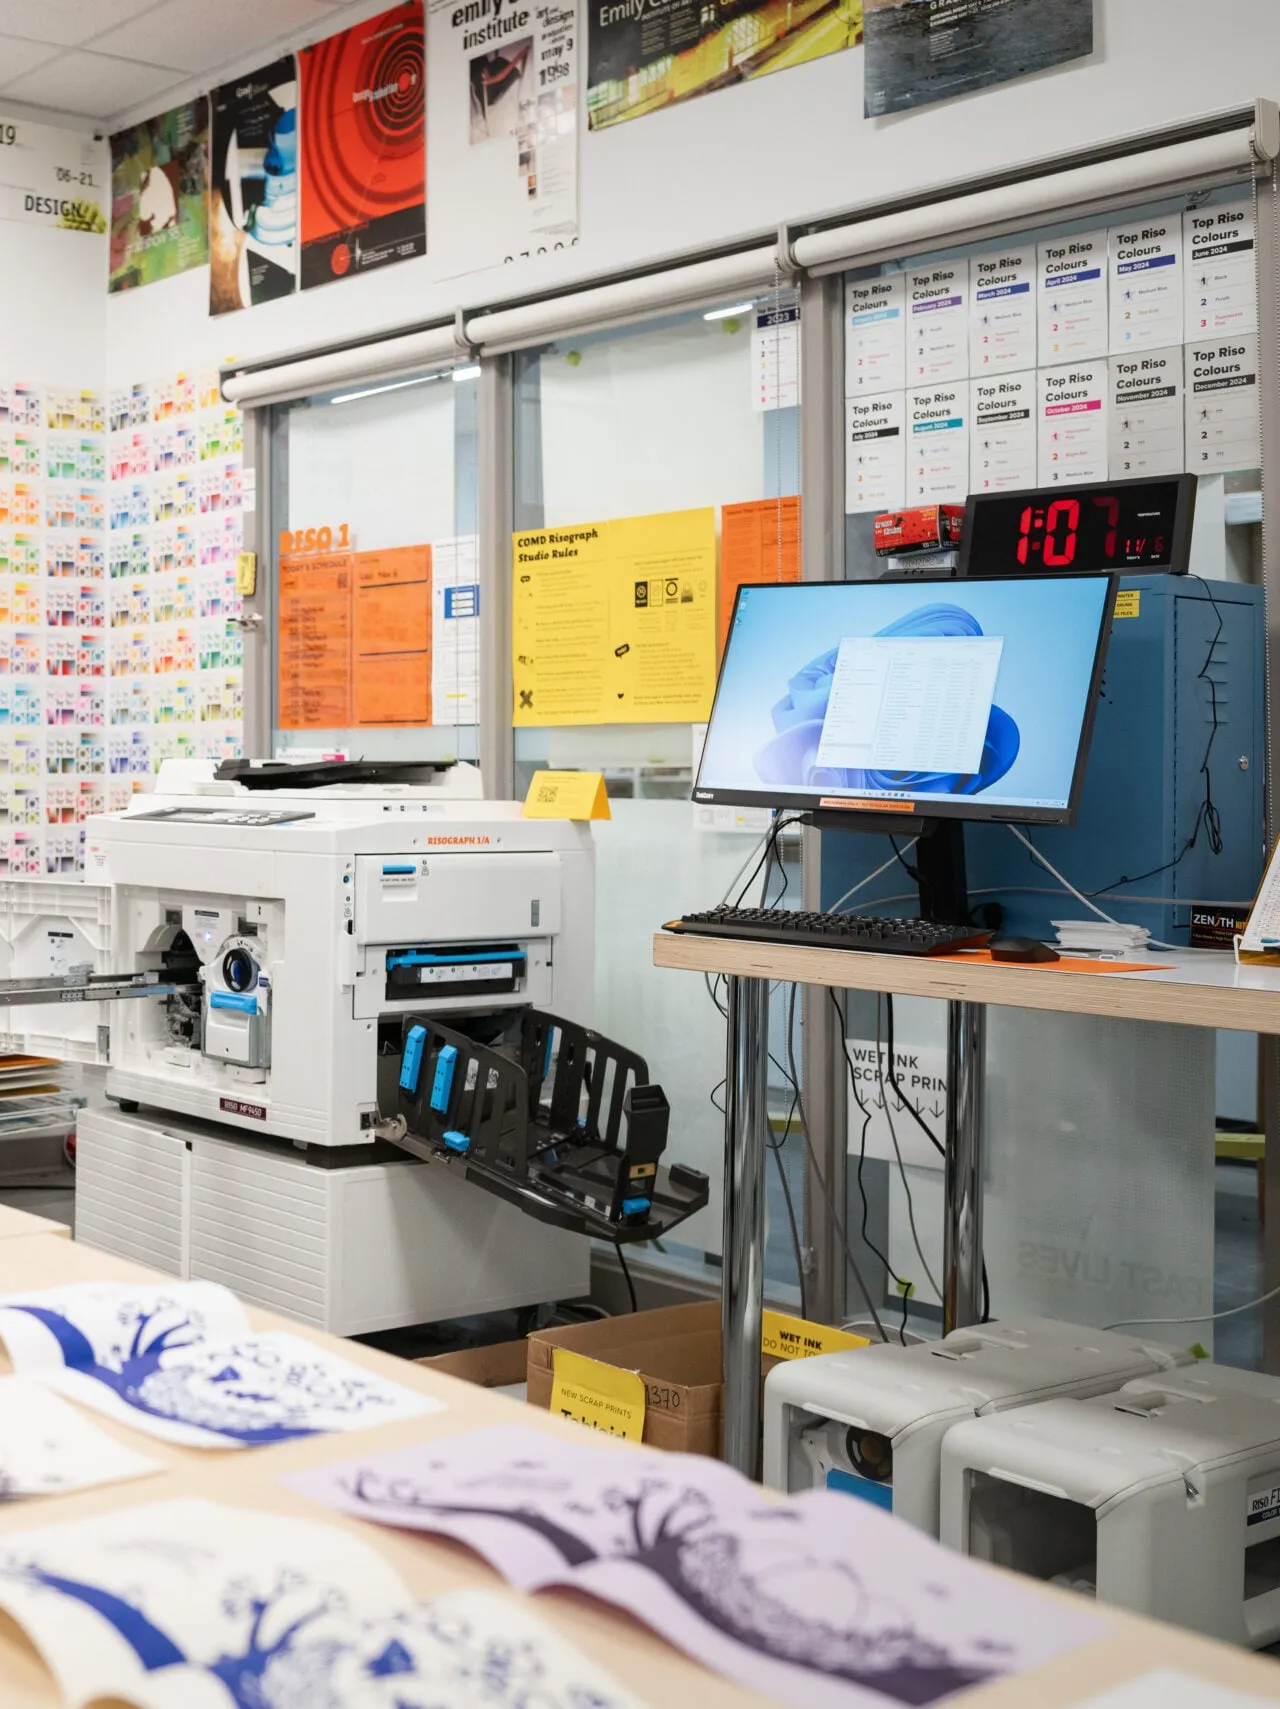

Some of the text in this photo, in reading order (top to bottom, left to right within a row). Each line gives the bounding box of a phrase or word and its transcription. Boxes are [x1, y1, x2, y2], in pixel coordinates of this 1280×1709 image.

[463, 10, 530, 50] institute
[541, 38, 573, 61] may 9
[25, 195, 83, 218] DESIGN
[1192, 211, 1244, 230] Top Riso
[1117, 228, 1166, 245] Top Riso
[1192, 229, 1239, 245] Colours
[1046, 242, 1093, 259] Top Riso
[1117, 244, 1161, 260] Colours
[1193, 246, 1228, 259] June 2024
[978, 257, 1022, 273] Top Riso
[1046, 258, 1088, 274] Colours
[1118, 261, 1149, 275] May 2024
[912, 271, 954, 287] Top Riso
[977, 272, 1017, 287] Colours
[1046, 274, 1078, 288] April 2024
[1200, 277, 1206, 285] 1
[852, 284, 892, 299] Top Riso
[912, 286, 950, 300] Colours
[978, 287, 1012, 300] March 2024
[852, 299, 888, 313] Colours
[1200, 298, 1207, 306] 2
[767, 312, 790, 325] 2023
[1200, 319, 1207, 328] 3
[1193, 345, 1246, 361] Top Riso
[1116, 358, 1166, 375] Top Riso
[1193, 363, 1241, 378] Colours
[1046, 372, 1093, 387] Top Riso
[1116, 375, 1161, 389] Colours
[1195, 376, 1248, 391] December 2024
[977, 382, 1022, 397] Top Riso
[1045, 389, 1088, 402] Colours
[1117, 388, 1169, 404] November 2024
[913, 392, 955, 406] Top Riso
[977, 398, 1017, 411] Colours
[853, 401, 893, 416] Top Riso
[913, 407, 951, 420] Colours
[1046, 403, 1088, 415] October 2024
[1201, 409, 1208, 418] 1
[852, 416, 889, 429] Colours
[1201, 431, 1208, 439] 2
[1201, 452, 1208, 460] 3
[338, 524, 349, 547] 1
[518, 529, 598, 548] COMD Risograph
[1017, 498, 1118, 566] 1:07
[518, 548, 579, 563] Studio Rules
[428, 836, 490, 845] RISOGRAPH 1/A
[853, 1048, 919, 1069] WET INK
[853, 1067, 905, 1085] SCRAP
[223, 1101, 262, 1117] RISO MF9450
[762, 1337, 802, 1355] DO NOT
[779, 1330, 823, 1350] WET INK
[561, 1388, 632, 1420] NEW SCRAP PRINTS
[1252, 1496, 1269, 1512] RISO
